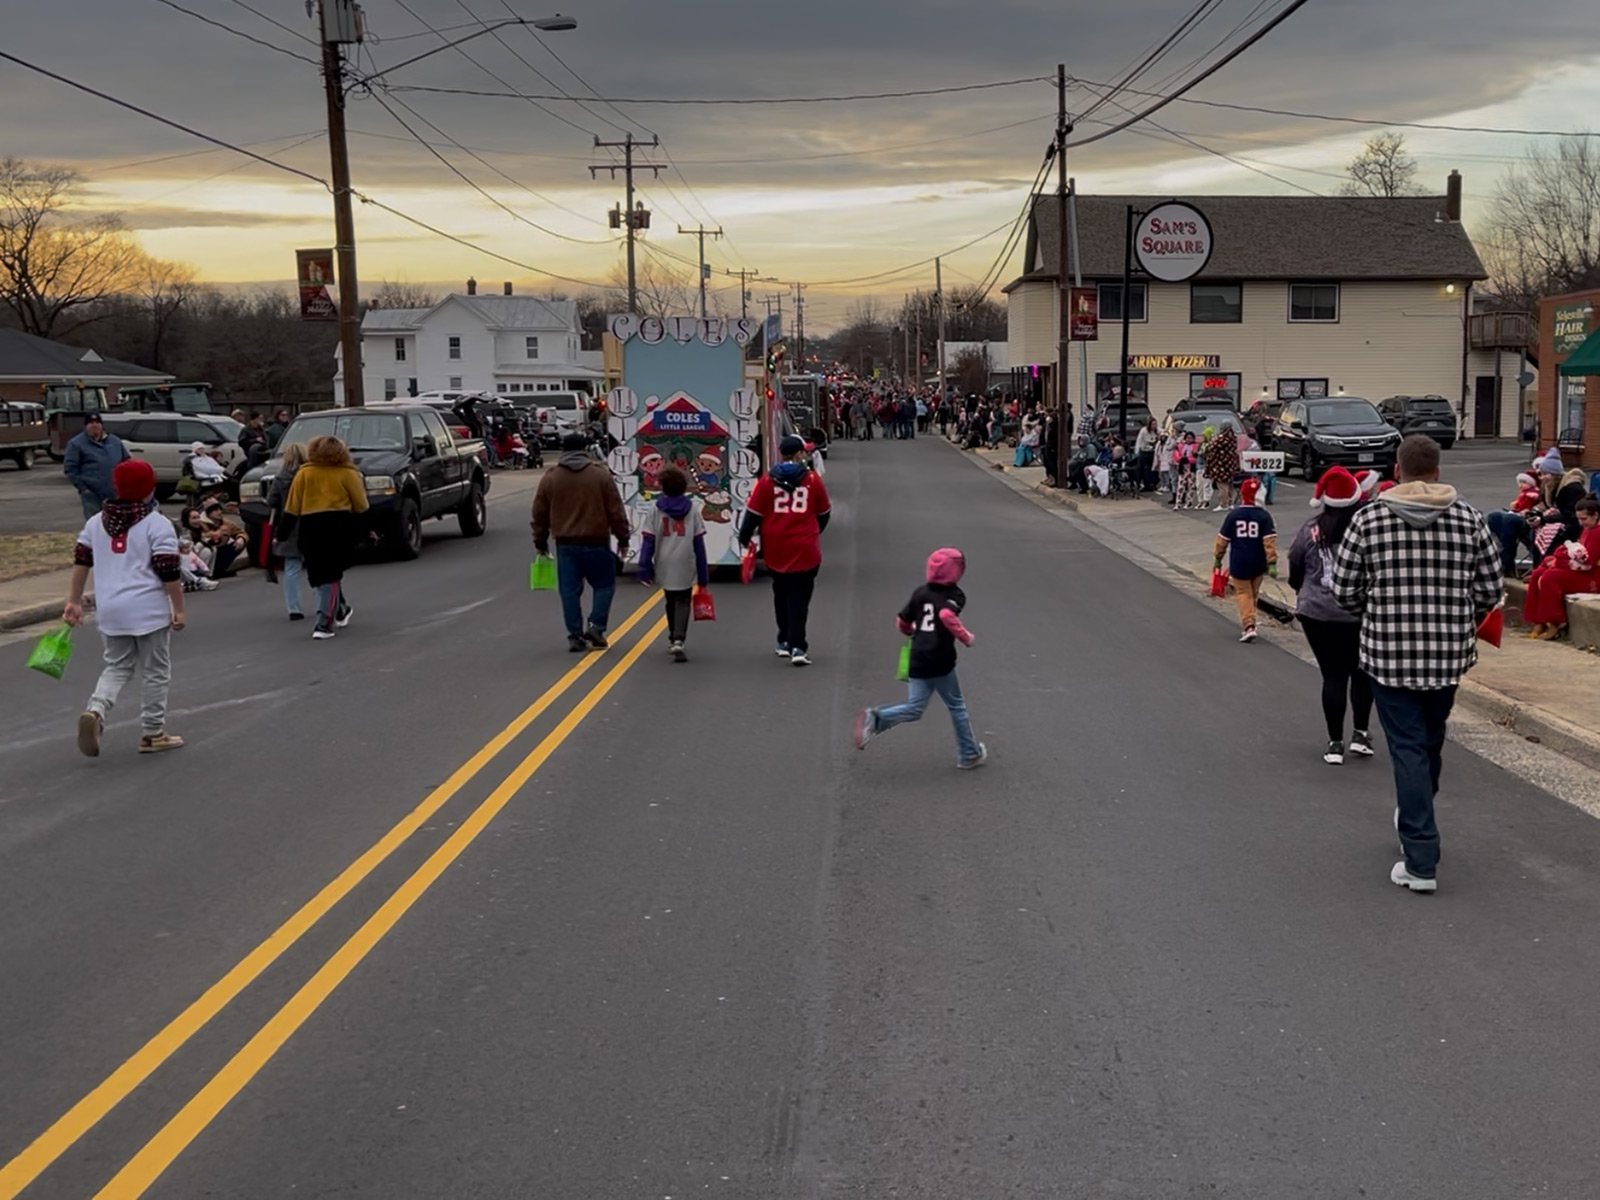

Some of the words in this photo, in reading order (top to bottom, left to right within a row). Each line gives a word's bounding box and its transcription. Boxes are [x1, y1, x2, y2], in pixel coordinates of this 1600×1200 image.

[1150, 217, 1197, 235] SAM'S
[1142, 236, 1204, 255] SQUARE
[612, 315, 750, 344] COLES
[1554, 322, 1584, 336] HAIR
[1171, 355, 1217, 368] PIZZERIA
[666, 412, 700, 423] COLES
[773, 487, 809, 514] 28
[1235, 520, 1259, 538] 28
